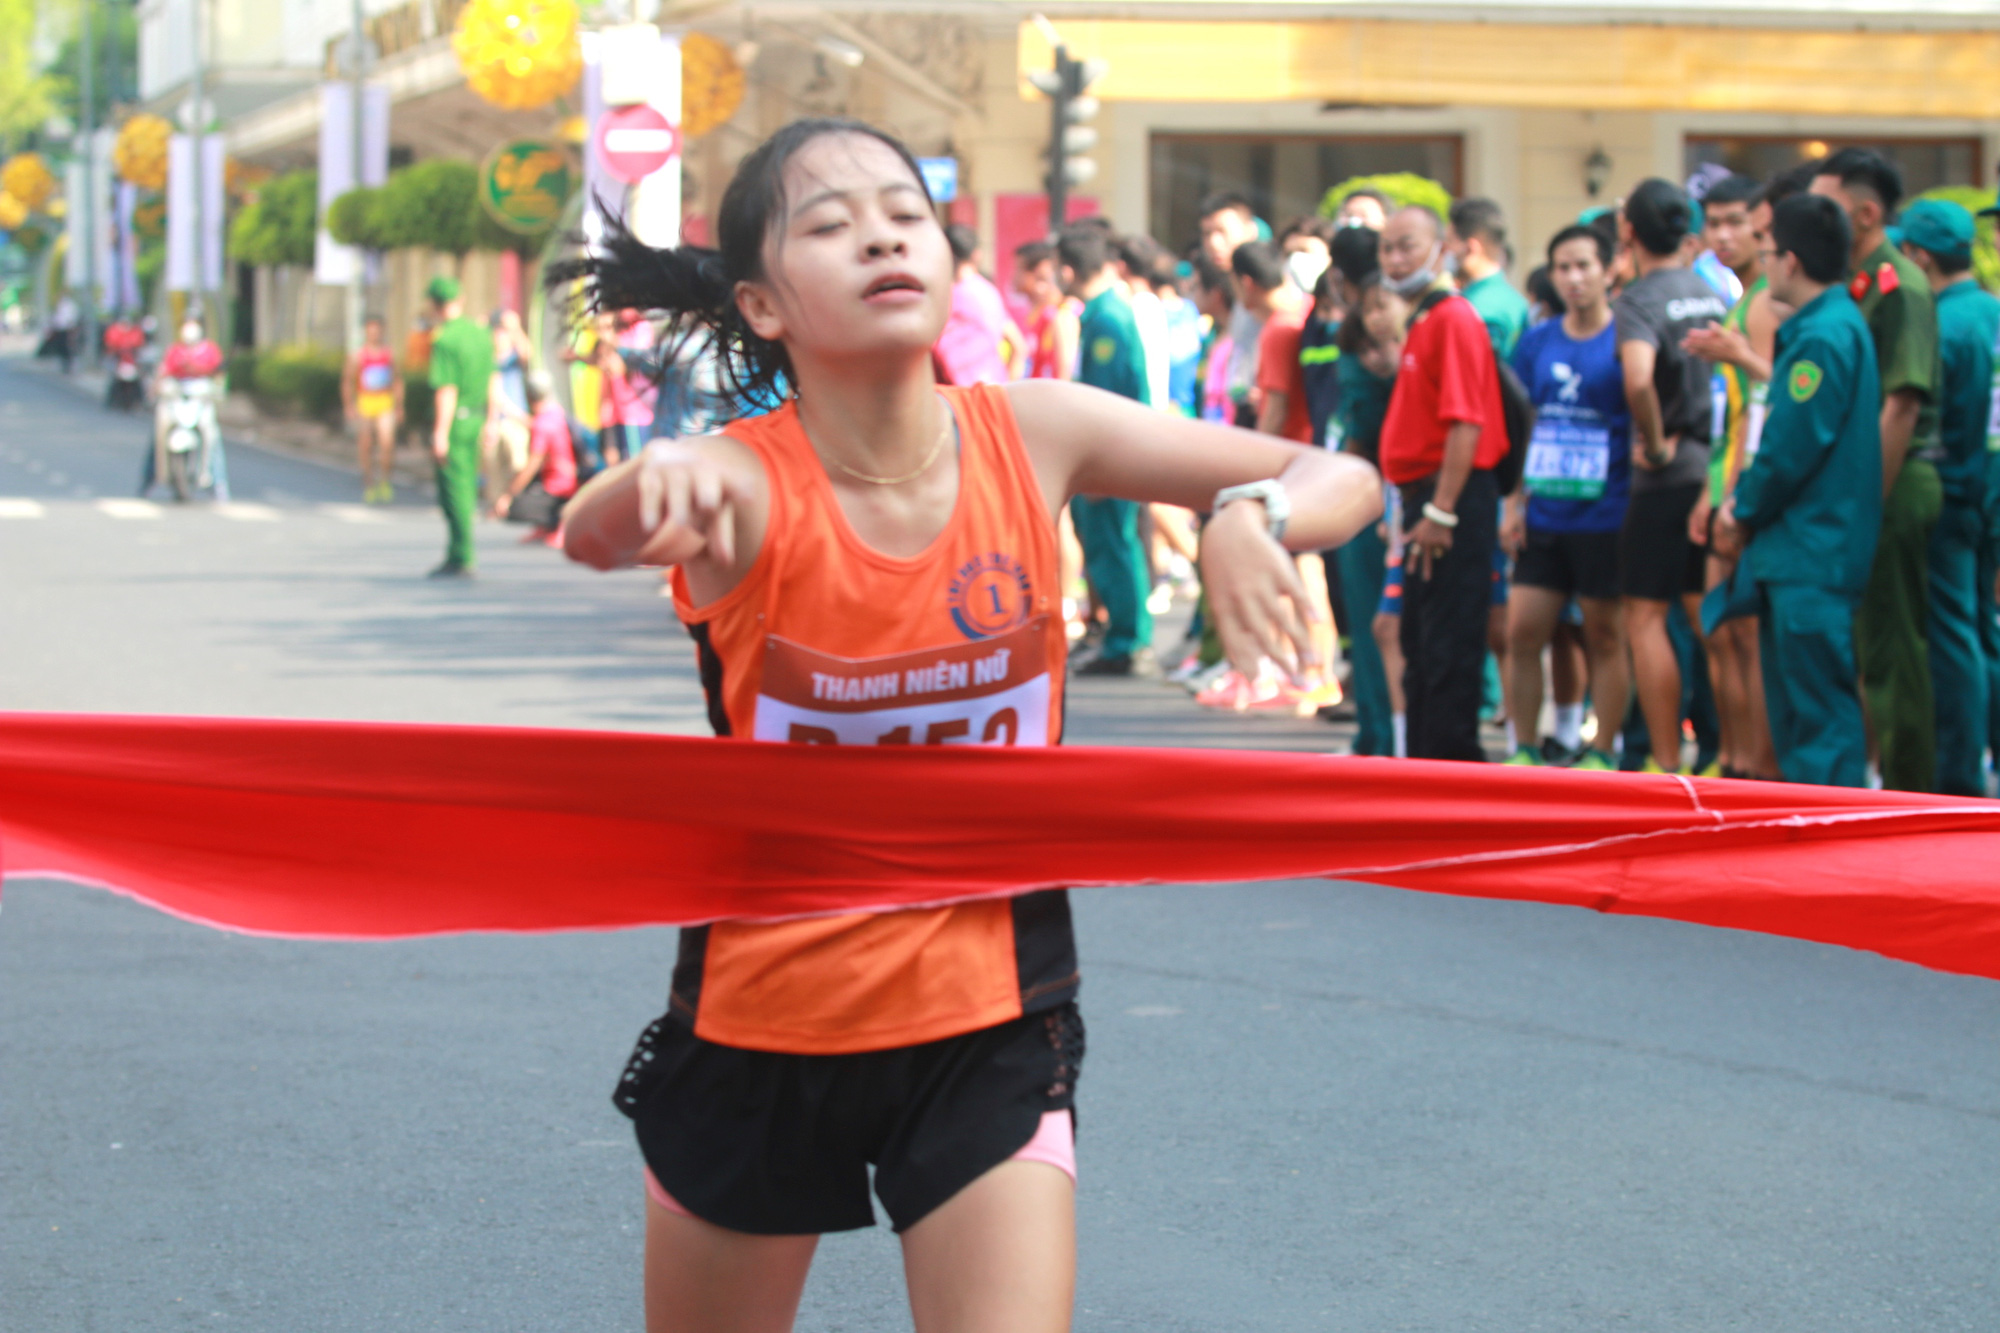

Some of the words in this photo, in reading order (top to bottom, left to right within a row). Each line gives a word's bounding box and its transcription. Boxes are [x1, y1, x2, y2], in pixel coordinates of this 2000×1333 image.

[984, 584, 1010, 616] 1
[811, 671, 899, 701] THANH
[905, 660, 968, 695] NIÊN
[974, 648, 1011, 685] NỮ
